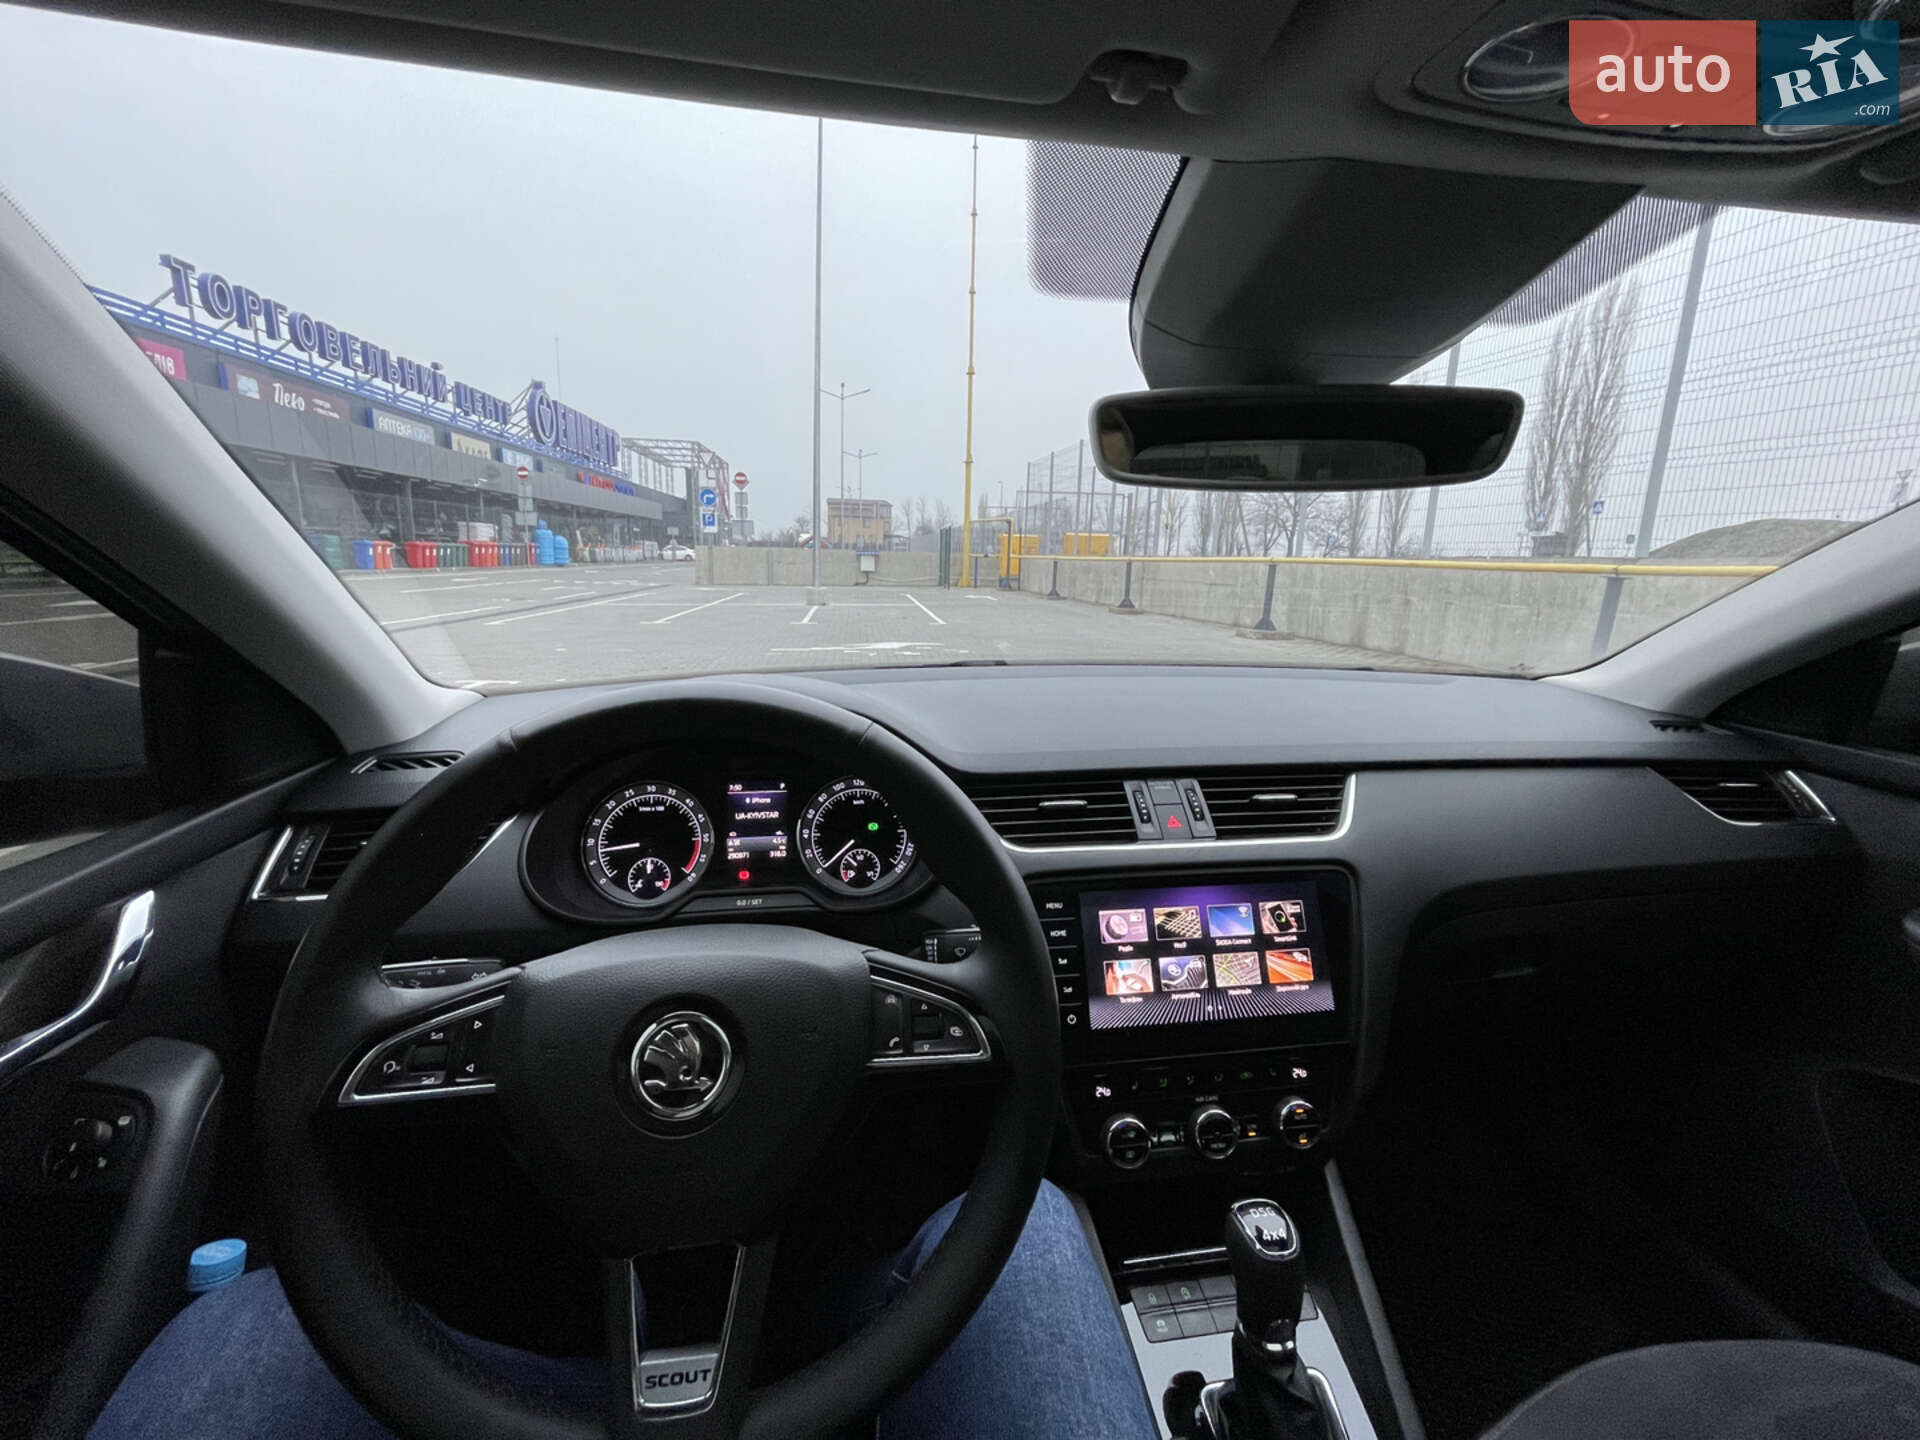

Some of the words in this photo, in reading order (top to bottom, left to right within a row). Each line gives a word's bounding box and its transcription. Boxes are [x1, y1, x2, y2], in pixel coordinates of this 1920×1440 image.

[454, 381, 512, 425] ЦЕНТР
[646, 785, 656, 793] 30
[832, 782, 846, 791] 100
[624, 789, 635, 798] 25
[668, 788, 677, 797] 35
[685, 798, 695, 808] 40
[818, 793, 828, 803] 80
[606, 800, 616, 810] 20
[698, 813, 705, 823] 45
[806, 808, 816, 819] 60
[592, 818, 602, 827] 15
[703, 833, 710, 843] 50
[802, 829, 810, 839] 40
[587, 838, 595, 847] 10
[700, 854, 707, 863] 55
[805, 849, 813, 858] 20
[688, 873, 697, 882] 60
[1046, 902, 1064, 910] MENU
[1250, 1207, 1275, 1218] DSG
[1262, 1228, 1288, 1241] 4x4
[645, 1368, 711, 1389] SCOUT
